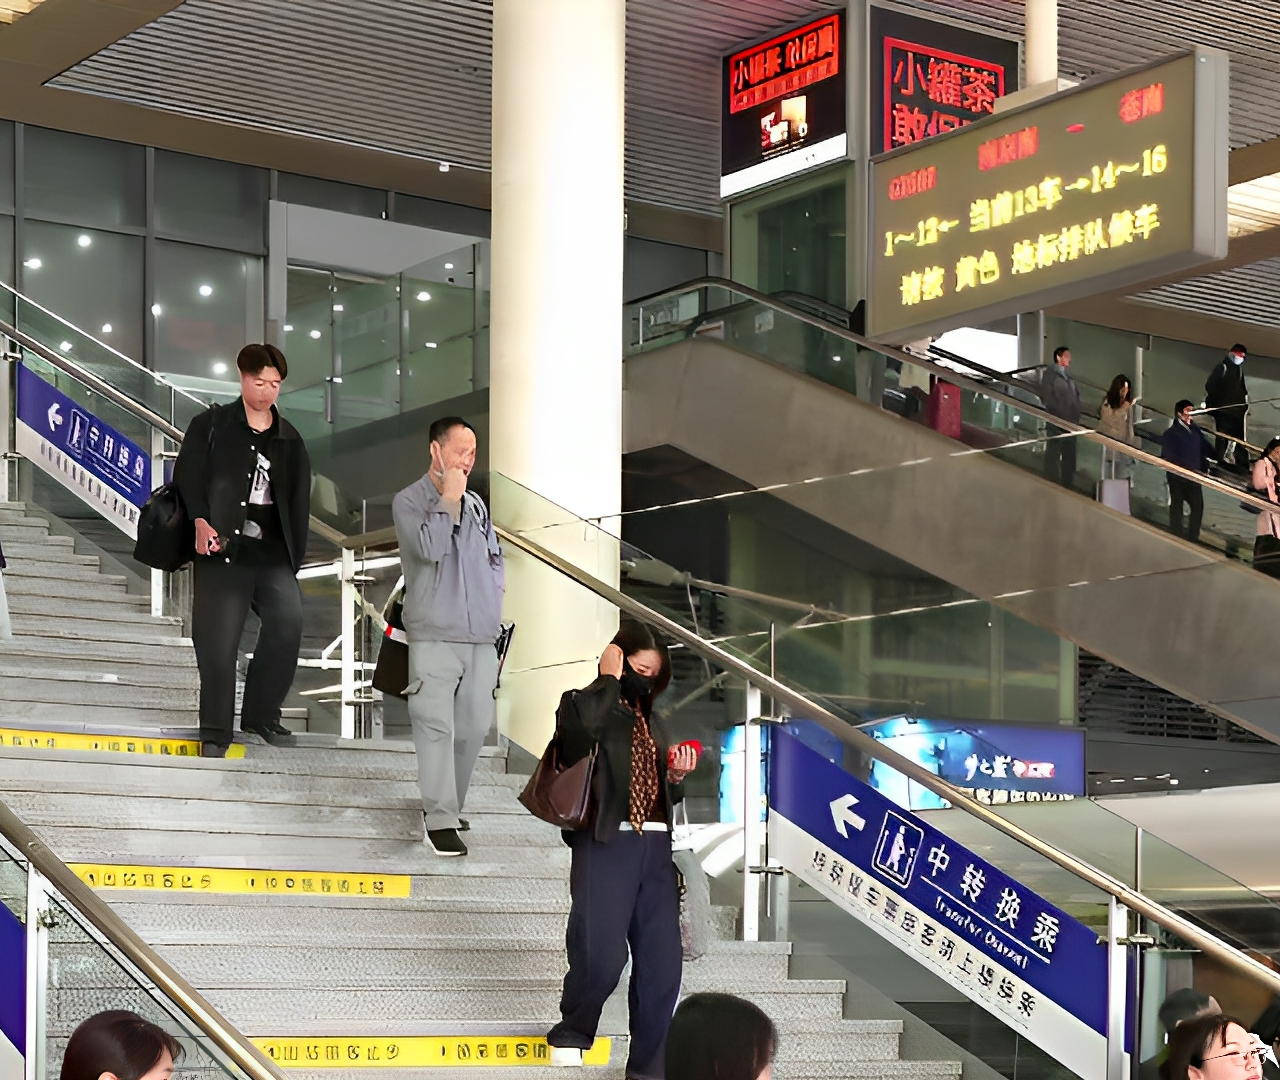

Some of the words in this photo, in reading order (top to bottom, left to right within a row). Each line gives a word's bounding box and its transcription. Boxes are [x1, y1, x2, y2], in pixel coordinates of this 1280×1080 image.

[893, 51, 996, 113] 小罐茶
[926, 843, 1062, 954] 中转换乘
